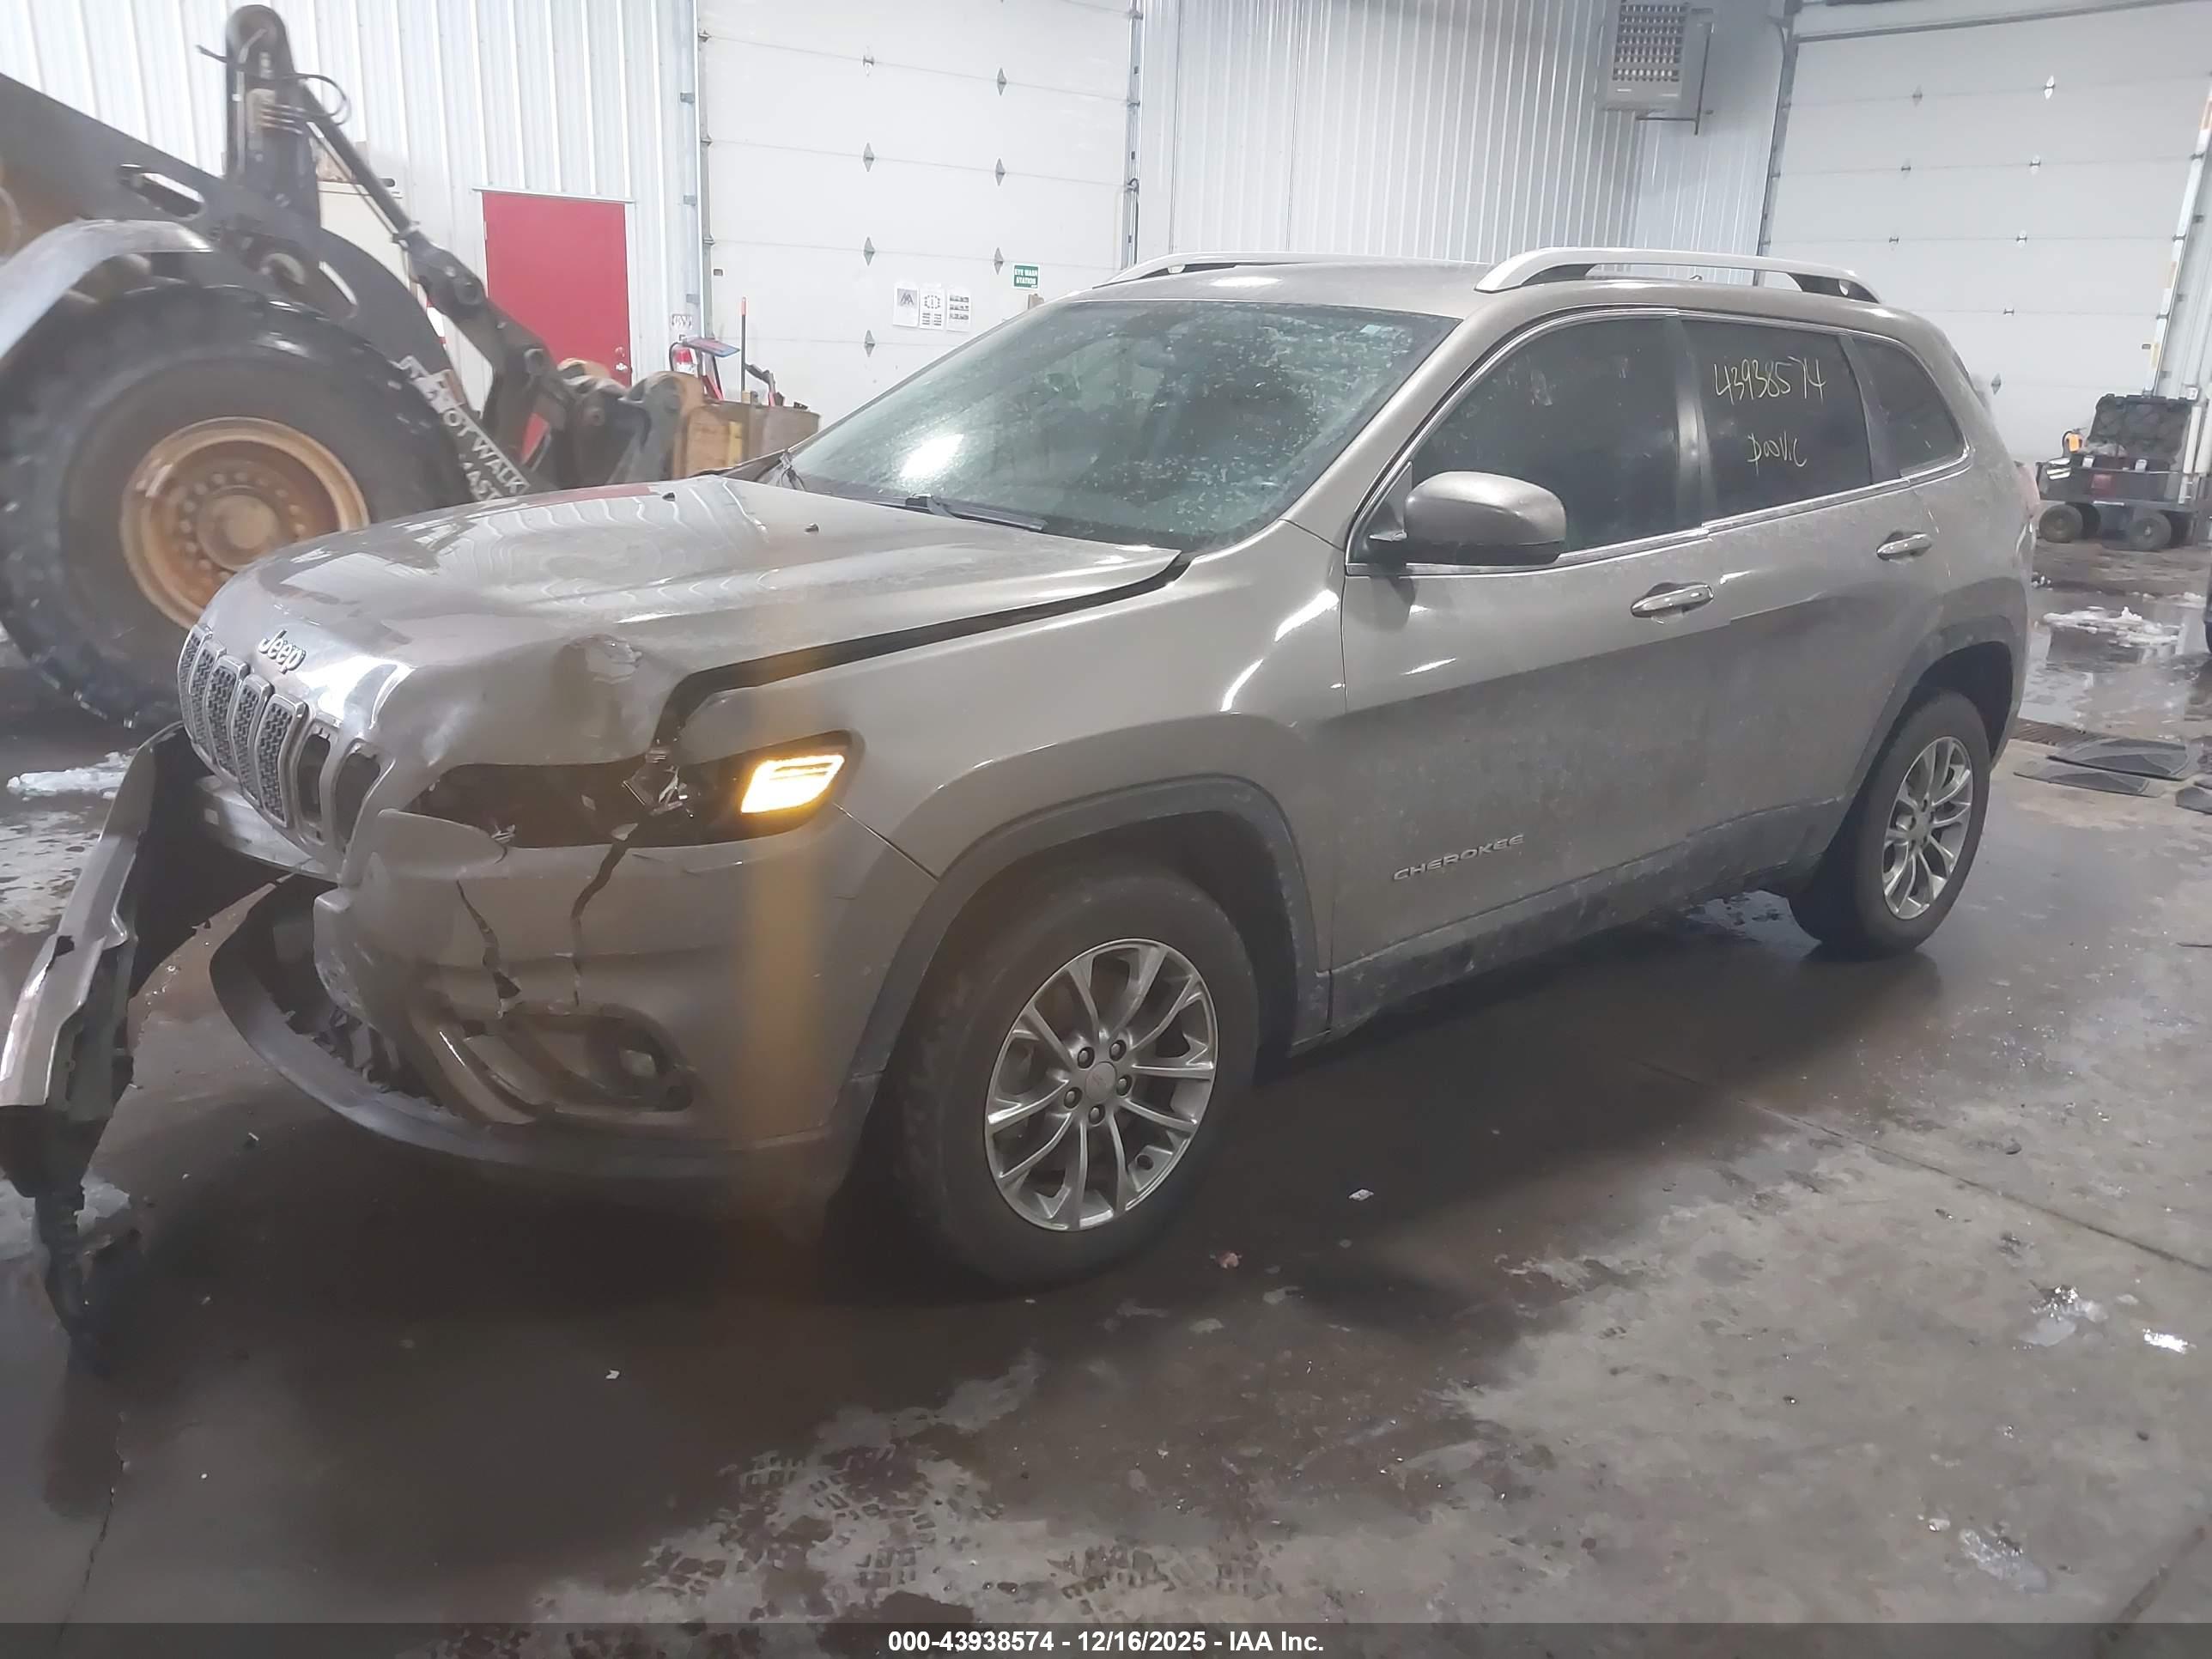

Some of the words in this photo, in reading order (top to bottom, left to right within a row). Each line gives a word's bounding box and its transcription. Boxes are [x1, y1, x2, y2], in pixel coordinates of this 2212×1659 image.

[472, 436, 526, 495] WALK
[258, 629, 307, 675] Jeep
[1393, 834, 1524, 881] CHEROKEE
